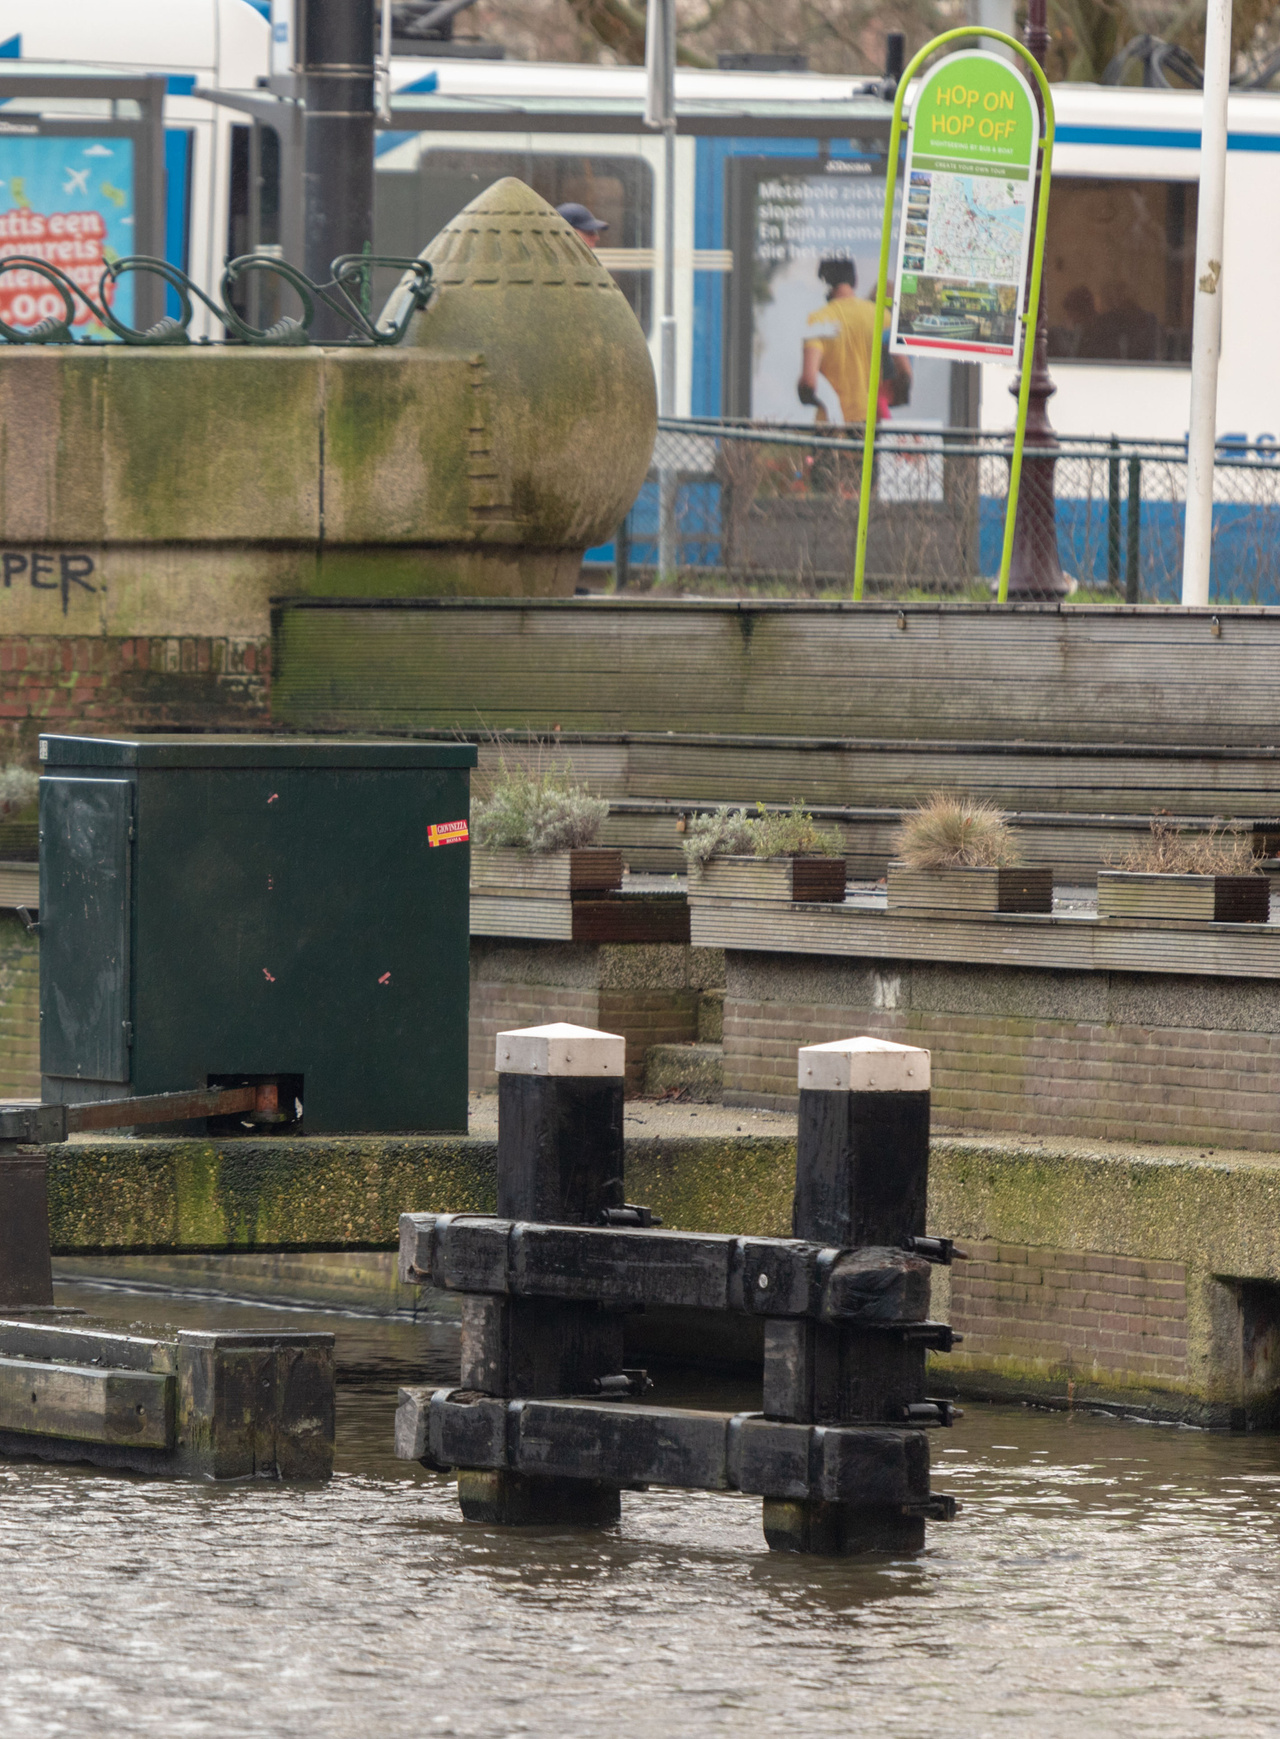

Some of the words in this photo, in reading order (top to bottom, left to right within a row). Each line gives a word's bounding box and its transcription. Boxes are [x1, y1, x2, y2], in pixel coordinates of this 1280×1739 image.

[936, 85, 979, 109] HOP
[983, 90, 1014, 112] ON
[932, 114, 974, 135] HOP
[978, 118, 1017, 141] OFF
[759, 182, 838, 200] Metabole
[842, 182, 904, 200] ziektn
[759, 202, 814, 221] slopen
[49, 213, 100, 235] een
[759, 222, 781, 239] En
[437, 821, 467, 833] GIOVINEZZA
